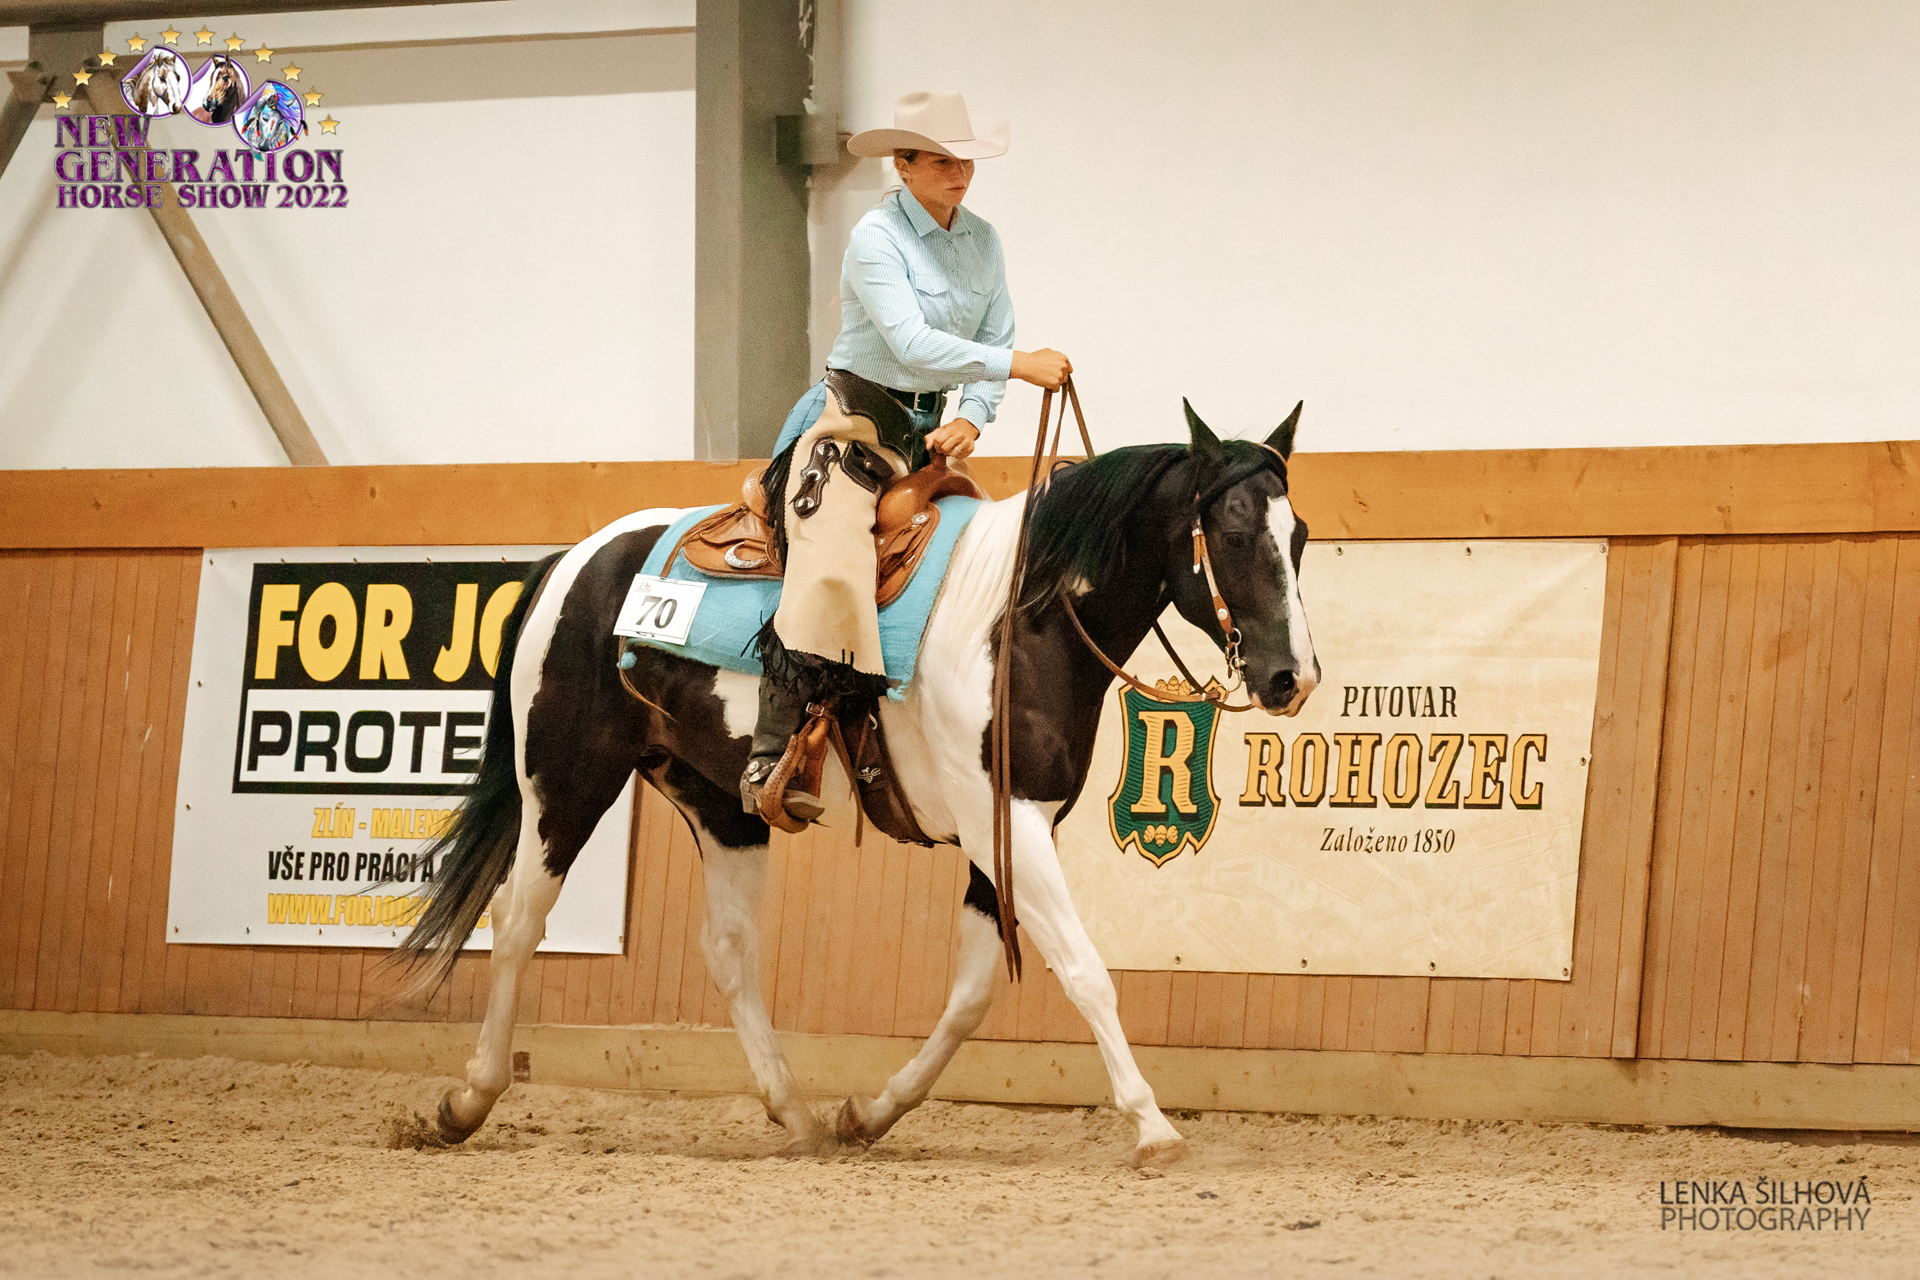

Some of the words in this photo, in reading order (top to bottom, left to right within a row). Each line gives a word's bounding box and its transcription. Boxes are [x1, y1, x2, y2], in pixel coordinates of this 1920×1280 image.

[635, 595, 678, 629] 70
[254, 582, 413, 682] FOR
[433, 580, 525, 683] JO
[1340, 686, 1458, 718] PIVOVAR
[246, 709, 487, 774] PROTE
[1130, 711, 1198, 821] R
[1239, 732, 1548, 810] ROHOZEC
[311, 802, 356, 839] ZLÍN
[370, 808, 462, 840] MALEN
[1319, 826, 1408, 855] Založeno
[1413, 828, 1456, 854] 1850
[268, 845, 306, 881] VŠE
[309, 851, 350, 882] PRO
[354, 847, 418, 883] PRÁCI
[420, 852, 435, 883] A
